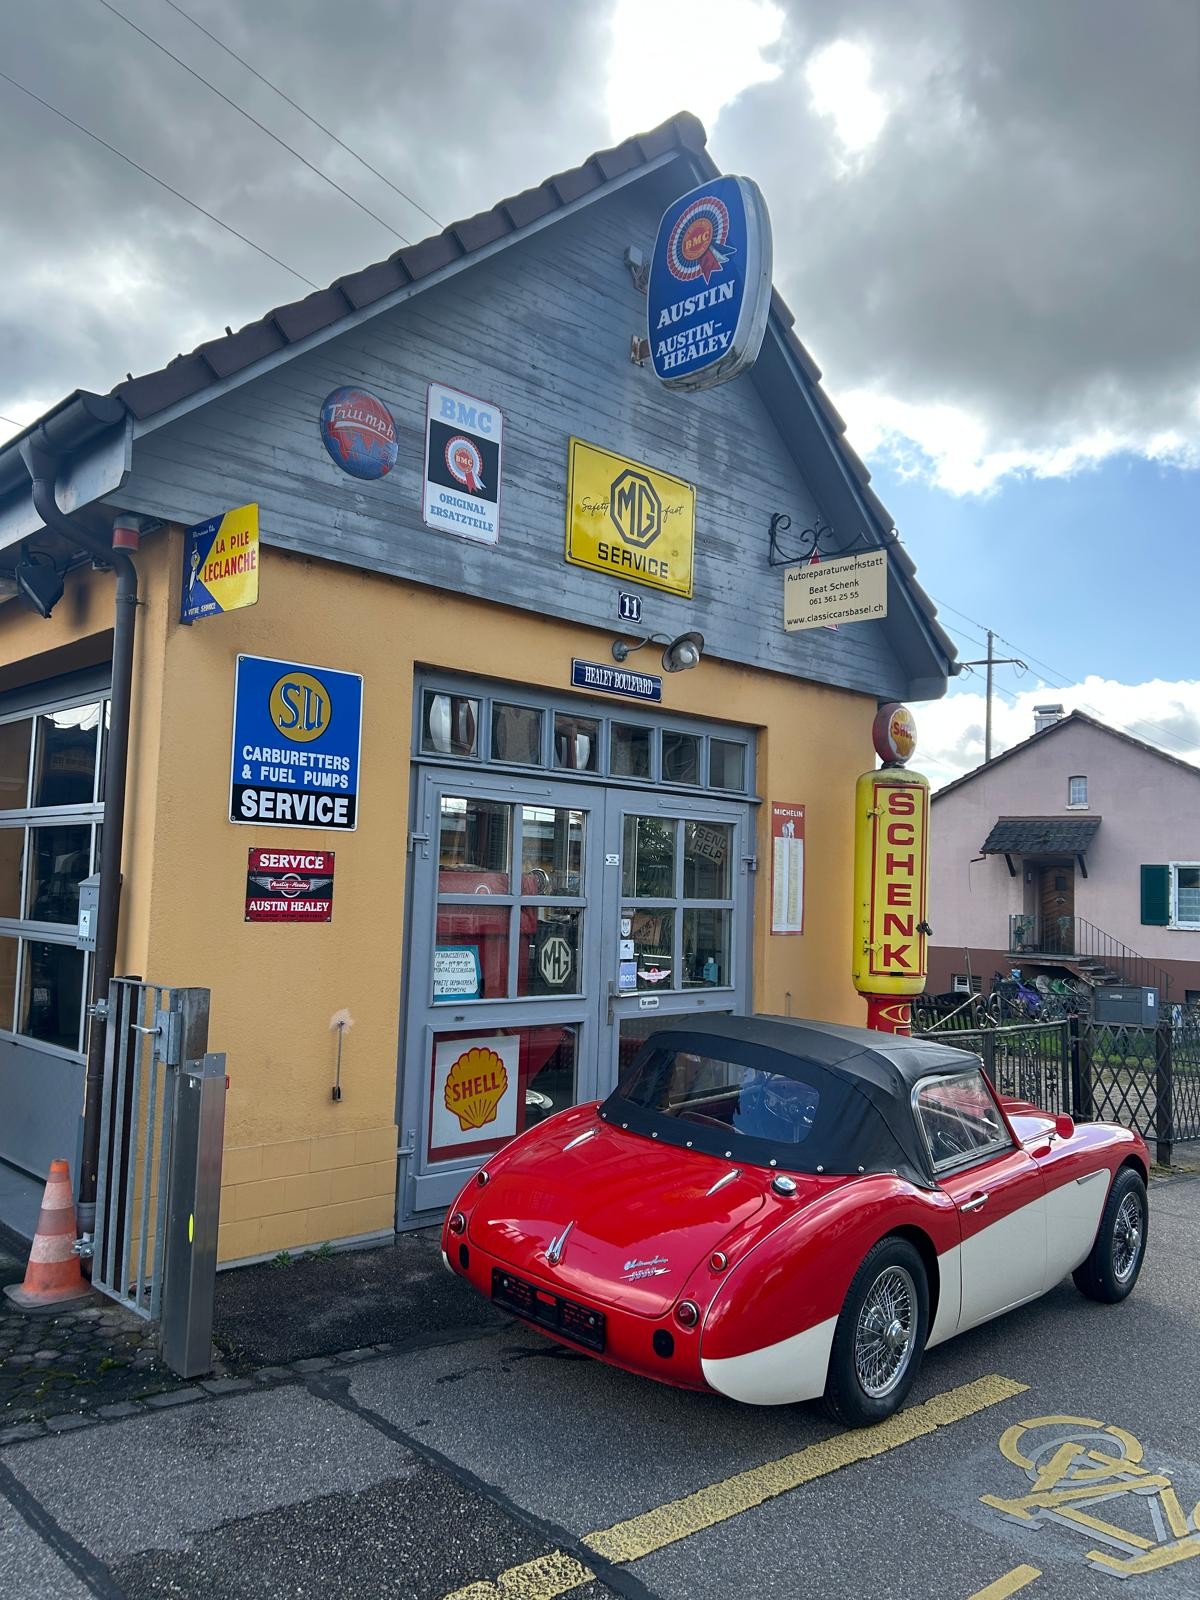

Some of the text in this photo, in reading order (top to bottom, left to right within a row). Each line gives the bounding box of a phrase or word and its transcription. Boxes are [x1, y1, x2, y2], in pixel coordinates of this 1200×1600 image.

[685, 231, 710, 250] BMC
[656, 280, 735, 329] AUSTIN
[655, 319, 723, 358] AUSTIN-
[663, 330, 732, 371] HEALEY
[328, 403, 395, 440] Triumph
[439, 395, 492, 434] BMC
[455, 454, 473, 467] BMC
[439, 493, 486, 516] ORIGINAL
[581, 496, 685, 522] Safety fast
[617, 481, 656, 539] MG
[430, 505, 494, 532] ERSATZTEILE
[215, 538, 226, 555] LA
[230, 531, 250, 550] PILE
[597, 542, 669, 579] SERVICE
[787, 557, 884, 582] Autoreparaturwerkstatt
[809, 579, 860, 595] Beat Schenk
[809, 597, 822, 606] 061
[839, 593, 848, 601] 25
[849, 591, 860, 599] 55
[624, 597, 638, 619] 11
[786, 603, 884, 625] www.classiccarsbasel.ch
[584, 666, 654, 695] HEALEY BOULEVARD
[242, 745, 350, 771] CARBURETTERS
[241, 764, 349, 789] & FUEL PUMPS
[240, 788, 349, 825] SERVICE
[774, 808, 804, 818] MICHELIN
[695, 840, 722, 859] HELP
[697, 829, 727, 850] SEND
[259, 853, 324, 870] SERVICE
[882, 791, 915, 969] SCHENK
[249, 901, 330, 912] AUSTIN HEALEY
[452, 1072, 501, 1103] SHELL
